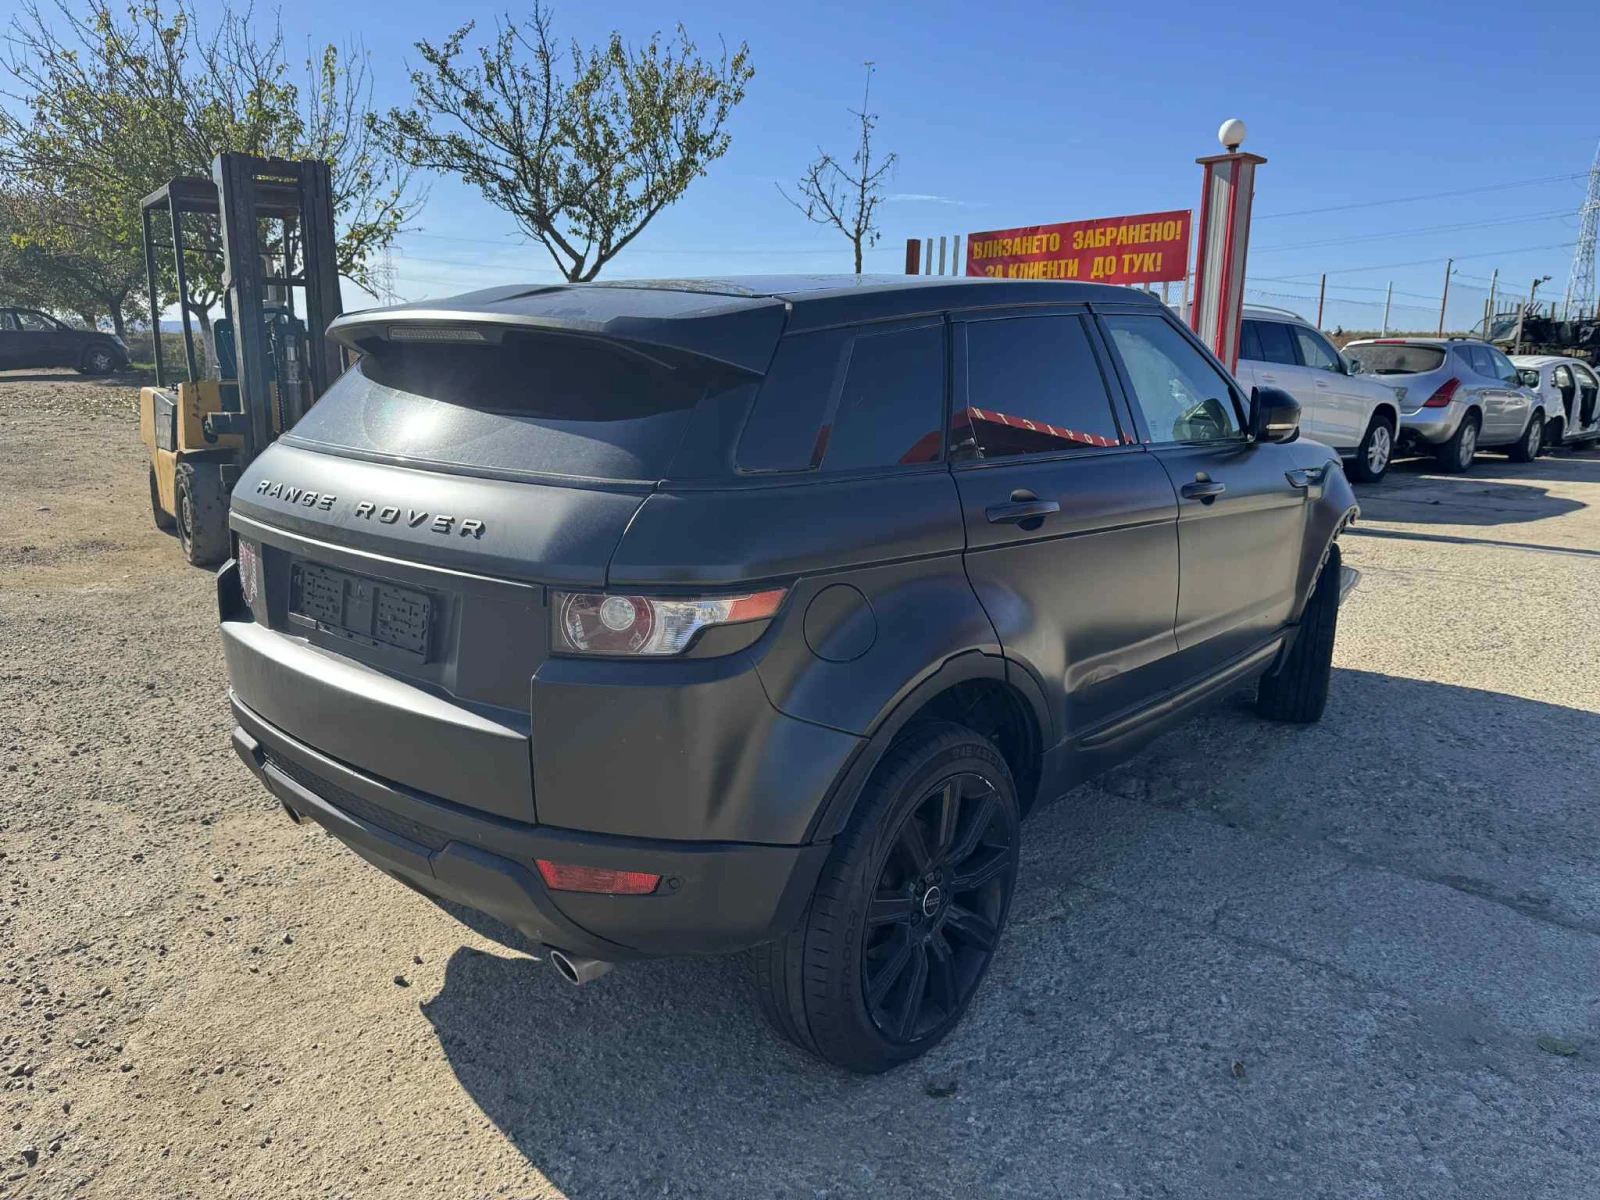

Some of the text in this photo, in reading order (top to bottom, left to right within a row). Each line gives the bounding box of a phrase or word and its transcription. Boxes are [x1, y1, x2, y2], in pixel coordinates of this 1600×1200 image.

[973, 220, 1183, 260] ВЛИЗАНЕТО ЗАБРАНЕНО!
[1008, 258, 1079, 279] КЛИЕНТИ
[1090, 255, 1116, 279] ДО
[1122, 252, 1163, 274] ТУК!
[256, 479, 487, 540] RANGE ROVER
